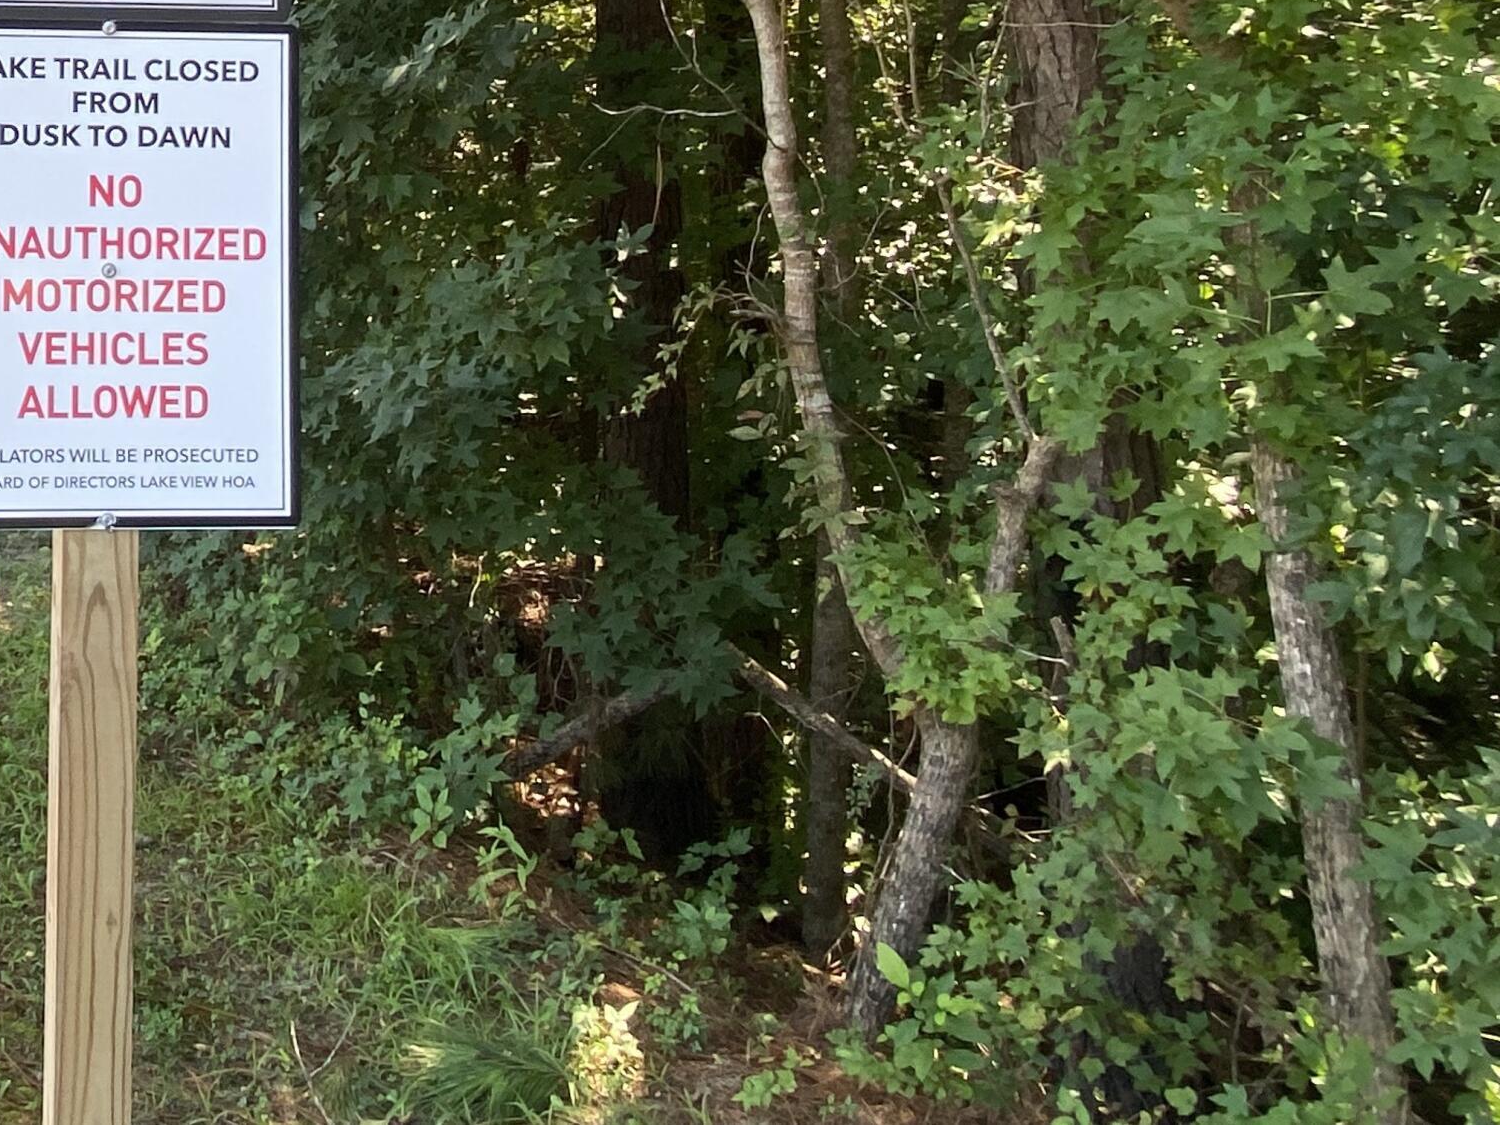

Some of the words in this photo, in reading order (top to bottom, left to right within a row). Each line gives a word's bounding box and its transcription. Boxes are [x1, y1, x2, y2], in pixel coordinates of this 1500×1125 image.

[53, 57, 137, 81] TRAIL
[143, 58, 260, 83] CLOSED
[72, 90, 159, 115] FROM
[0, 123, 82, 147] DUSK
[87, 124, 128, 148] TO
[137, 125, 231, 149] DAWN
[89, 174, 143, 208] NO
[3, 278, 226, 313] MOTORIZED
[17, 331, 209, 366] VEHICLES
[17, 384, 209, 419] ALLOWED
[68, 448, 111, 464] WILL
[115, 448, 138, 463] BE
[143, 447, 259, 463] PROSECUTED
[28, 476, 50, 489] OF
[54, 475, 136, 489] DIRECTORS
[140, 475, 178, 489] LAKE
[179, 475, 218, 488] VIEW
[222, 475, 256, 489] HOA
